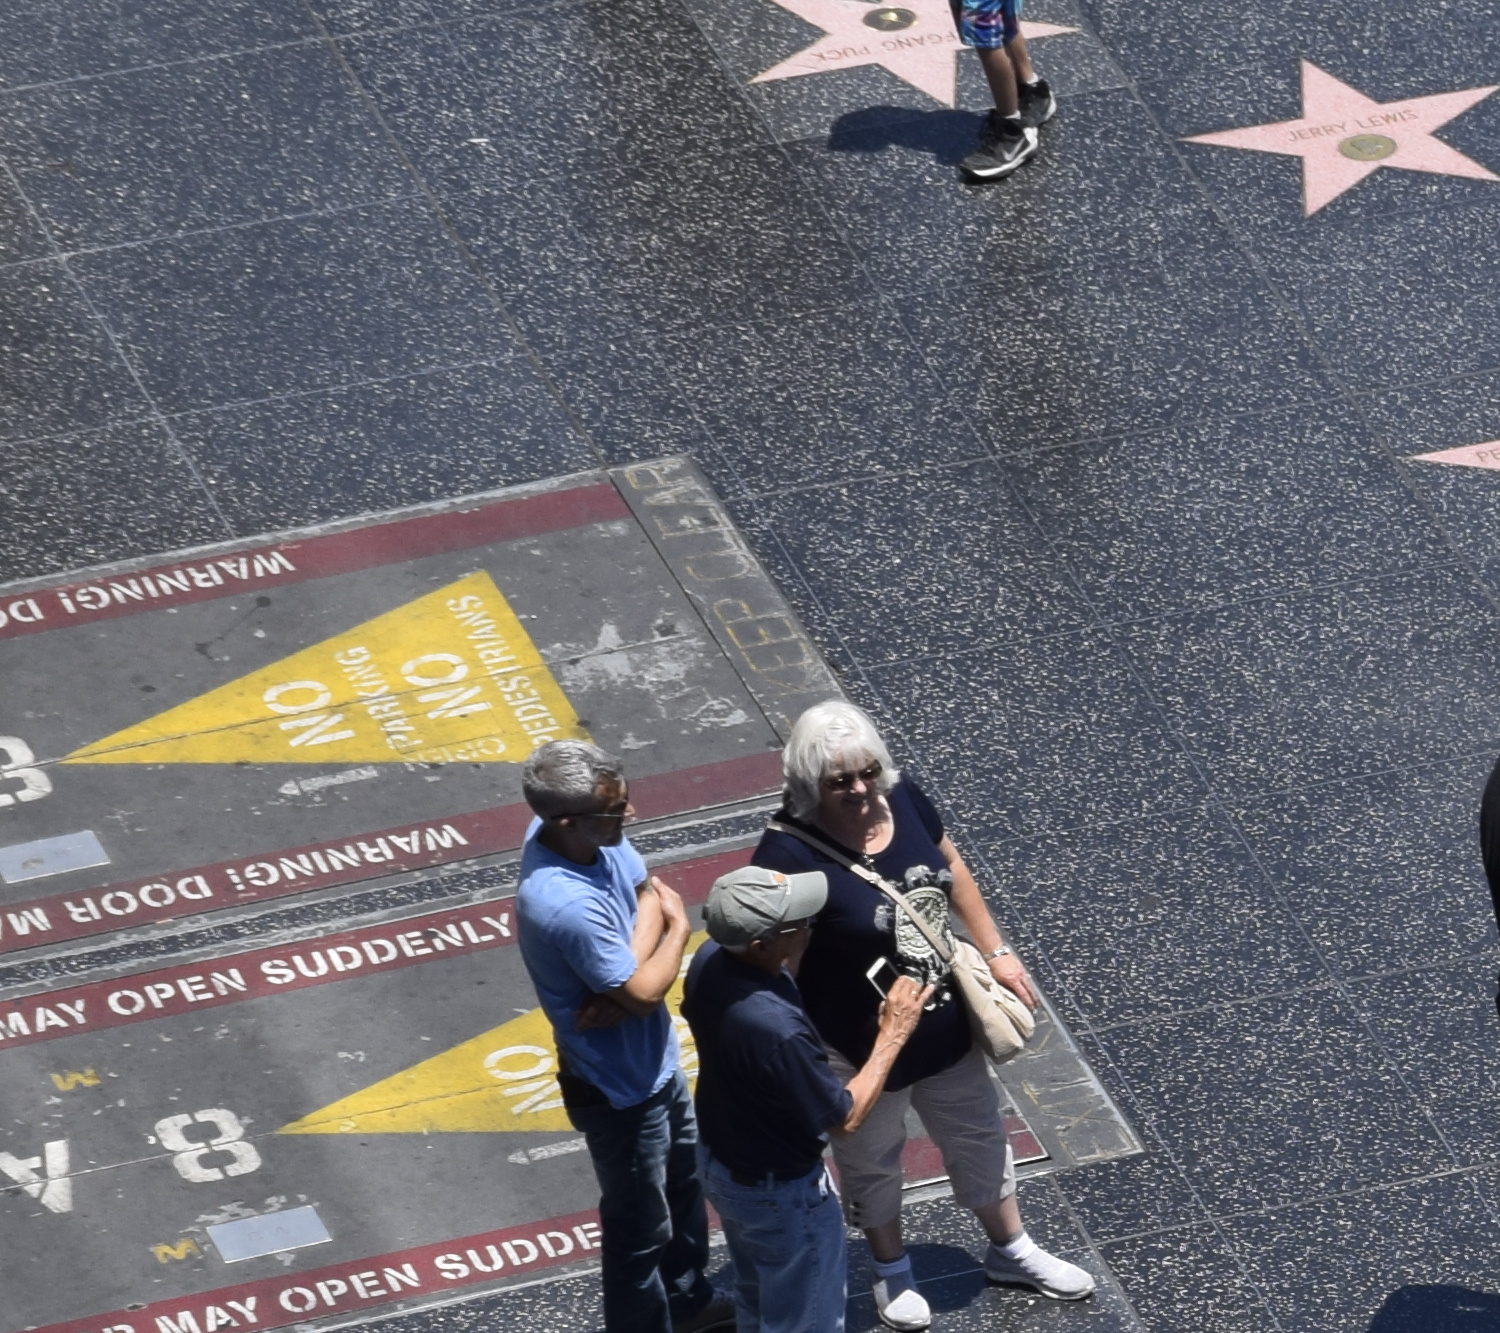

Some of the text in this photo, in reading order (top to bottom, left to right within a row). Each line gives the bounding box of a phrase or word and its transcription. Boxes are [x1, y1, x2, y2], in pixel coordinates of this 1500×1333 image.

[810, 47, 871, 63] PUCK
[1288, 109, 1419, 142] JERRY LEWIS
[59, 551, 296, 614] WARNING!
[333, 646, 423, 750] PARKING
[400, 653, 493, 719] NO
[446, 594, 562, 746] PEDESTRIANS
[262, 680, 356, 747] NO
[225, 822, 468, 891] WARNING!
[64, 875, 214, 924] DOOR
[106, 967, 248, 1017] OPEN
[259, 912, 513, 985] SUDDENLY
[483, 1044, 564, 1115] NO
[279, 1263, 421, 1314] OPEN
